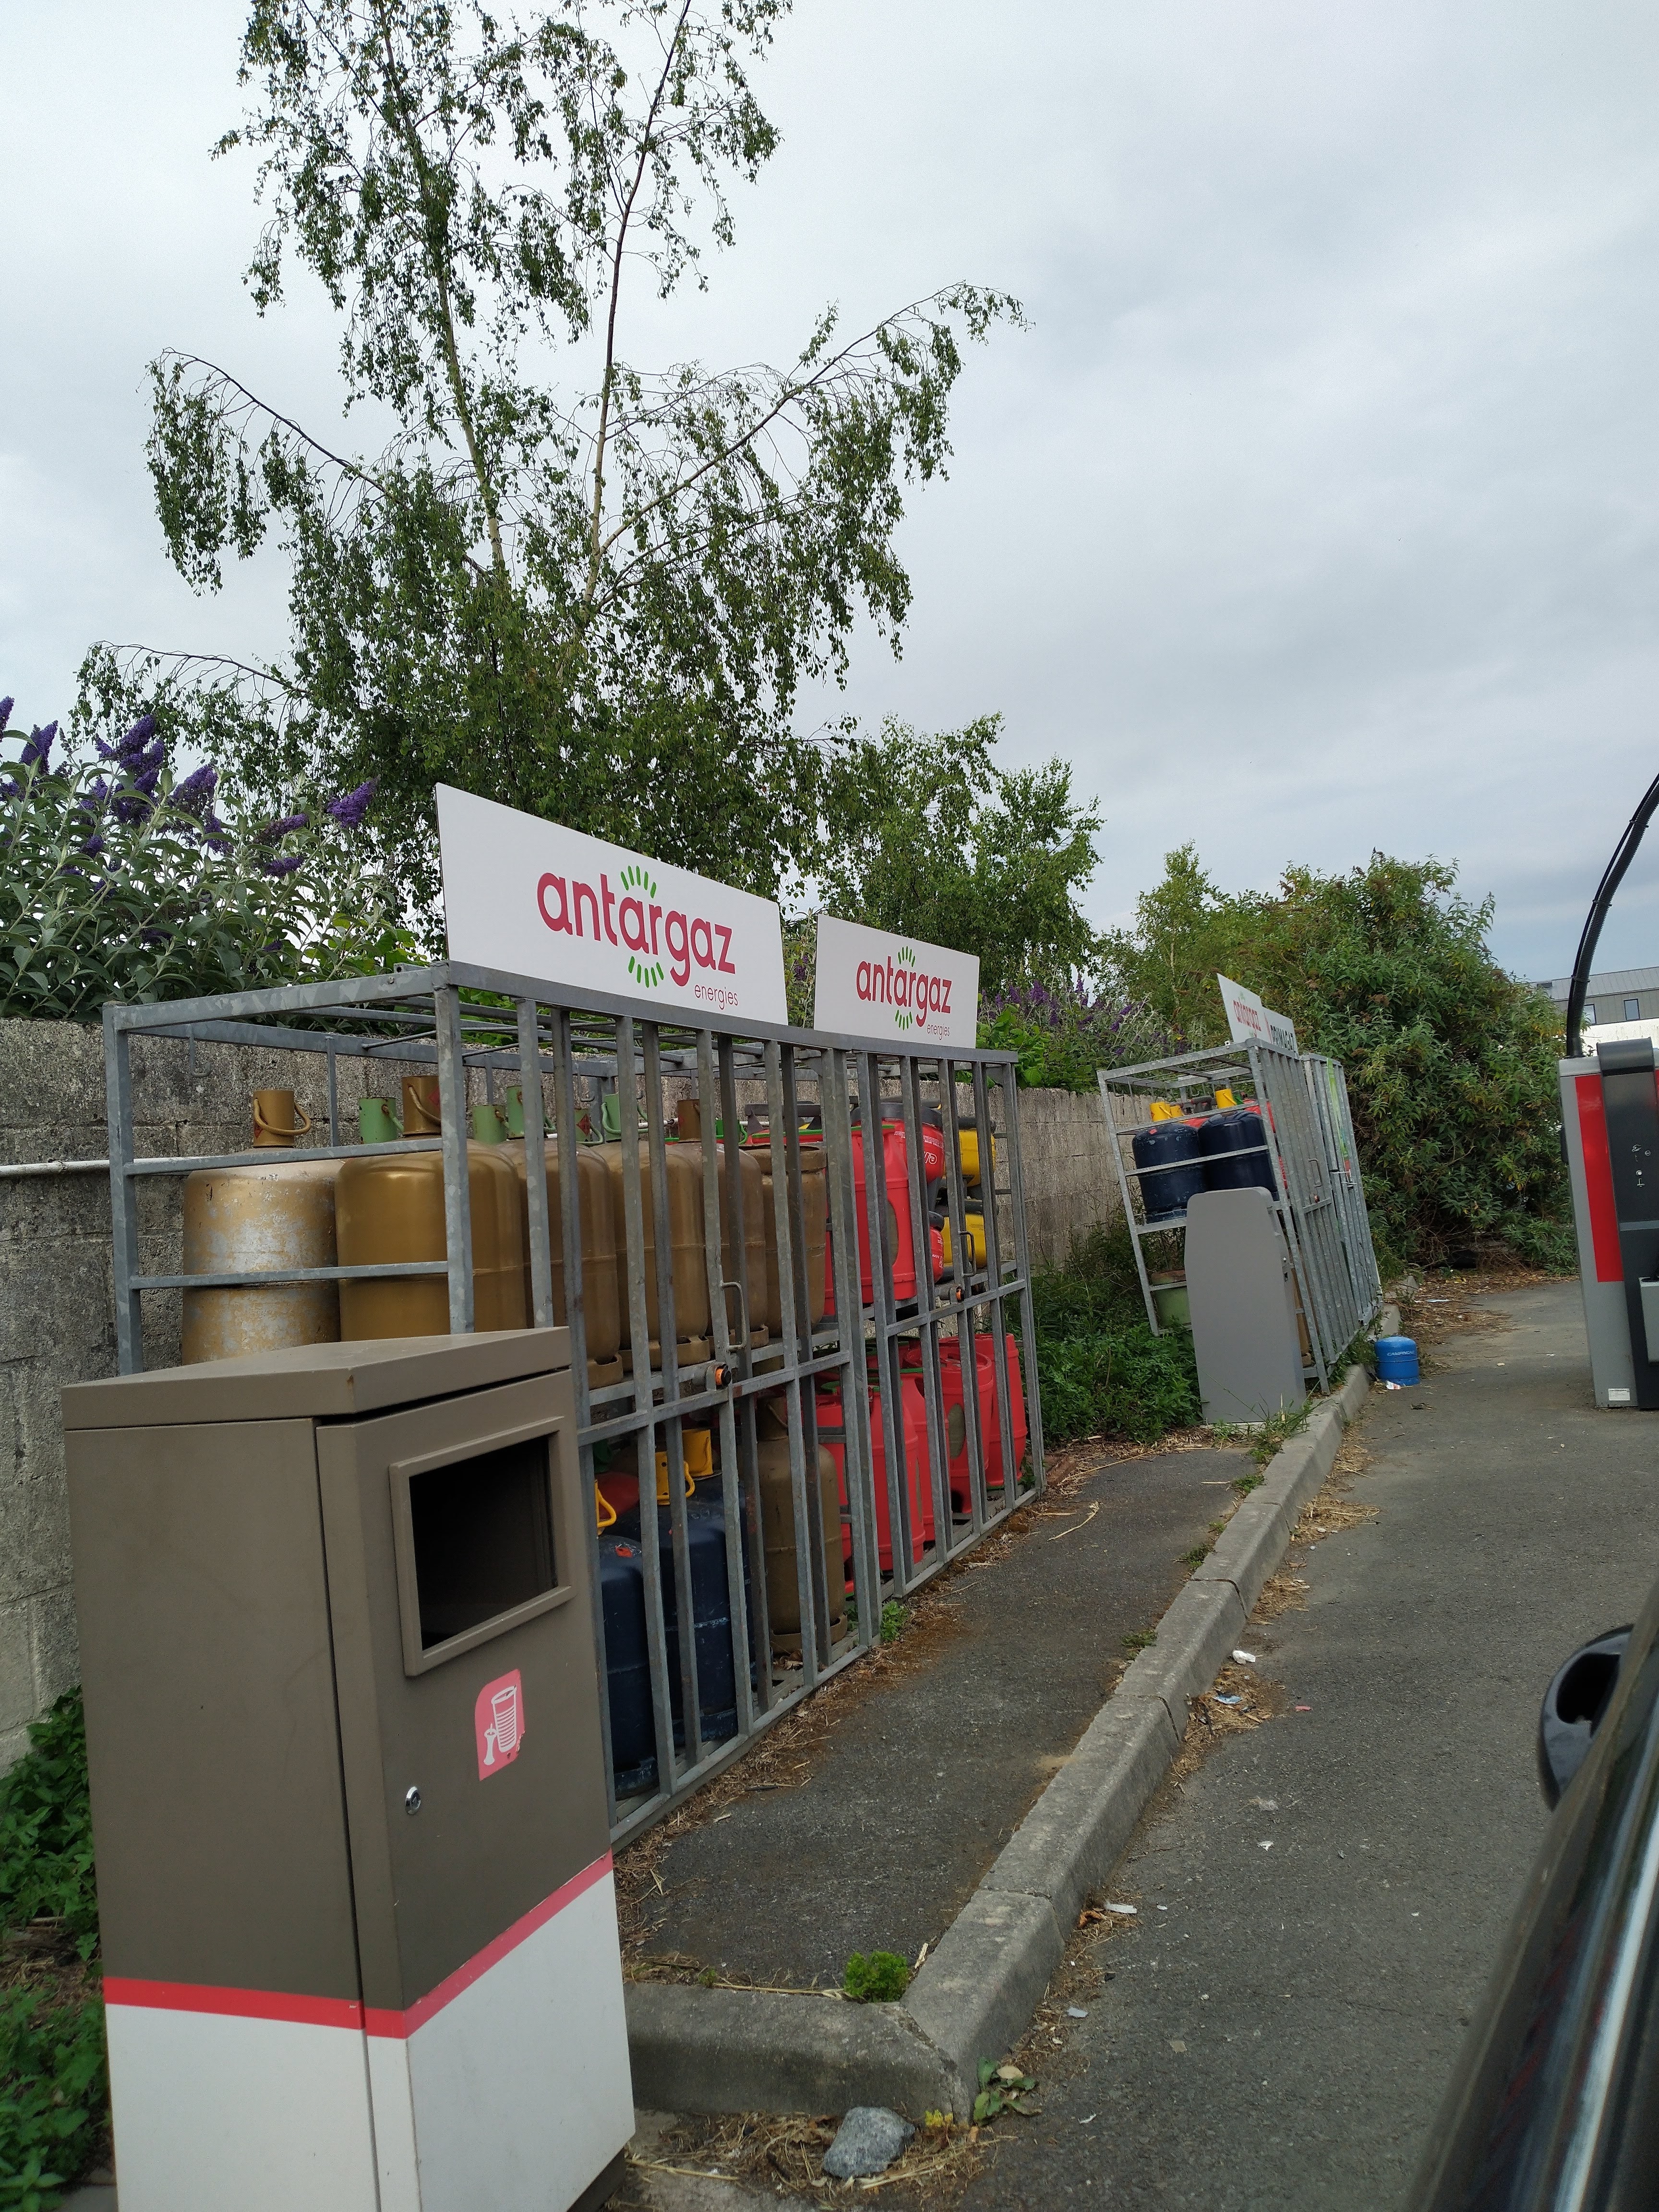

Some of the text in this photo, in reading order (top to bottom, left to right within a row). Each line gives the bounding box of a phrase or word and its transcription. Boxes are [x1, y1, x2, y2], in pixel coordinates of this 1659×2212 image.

[537, 872, 735, 986] antargaz
[694, 984, 739, 1010] energies
[856, 955, 952, 1027] antargaz
[926, 1024, 950, 1041] energies
